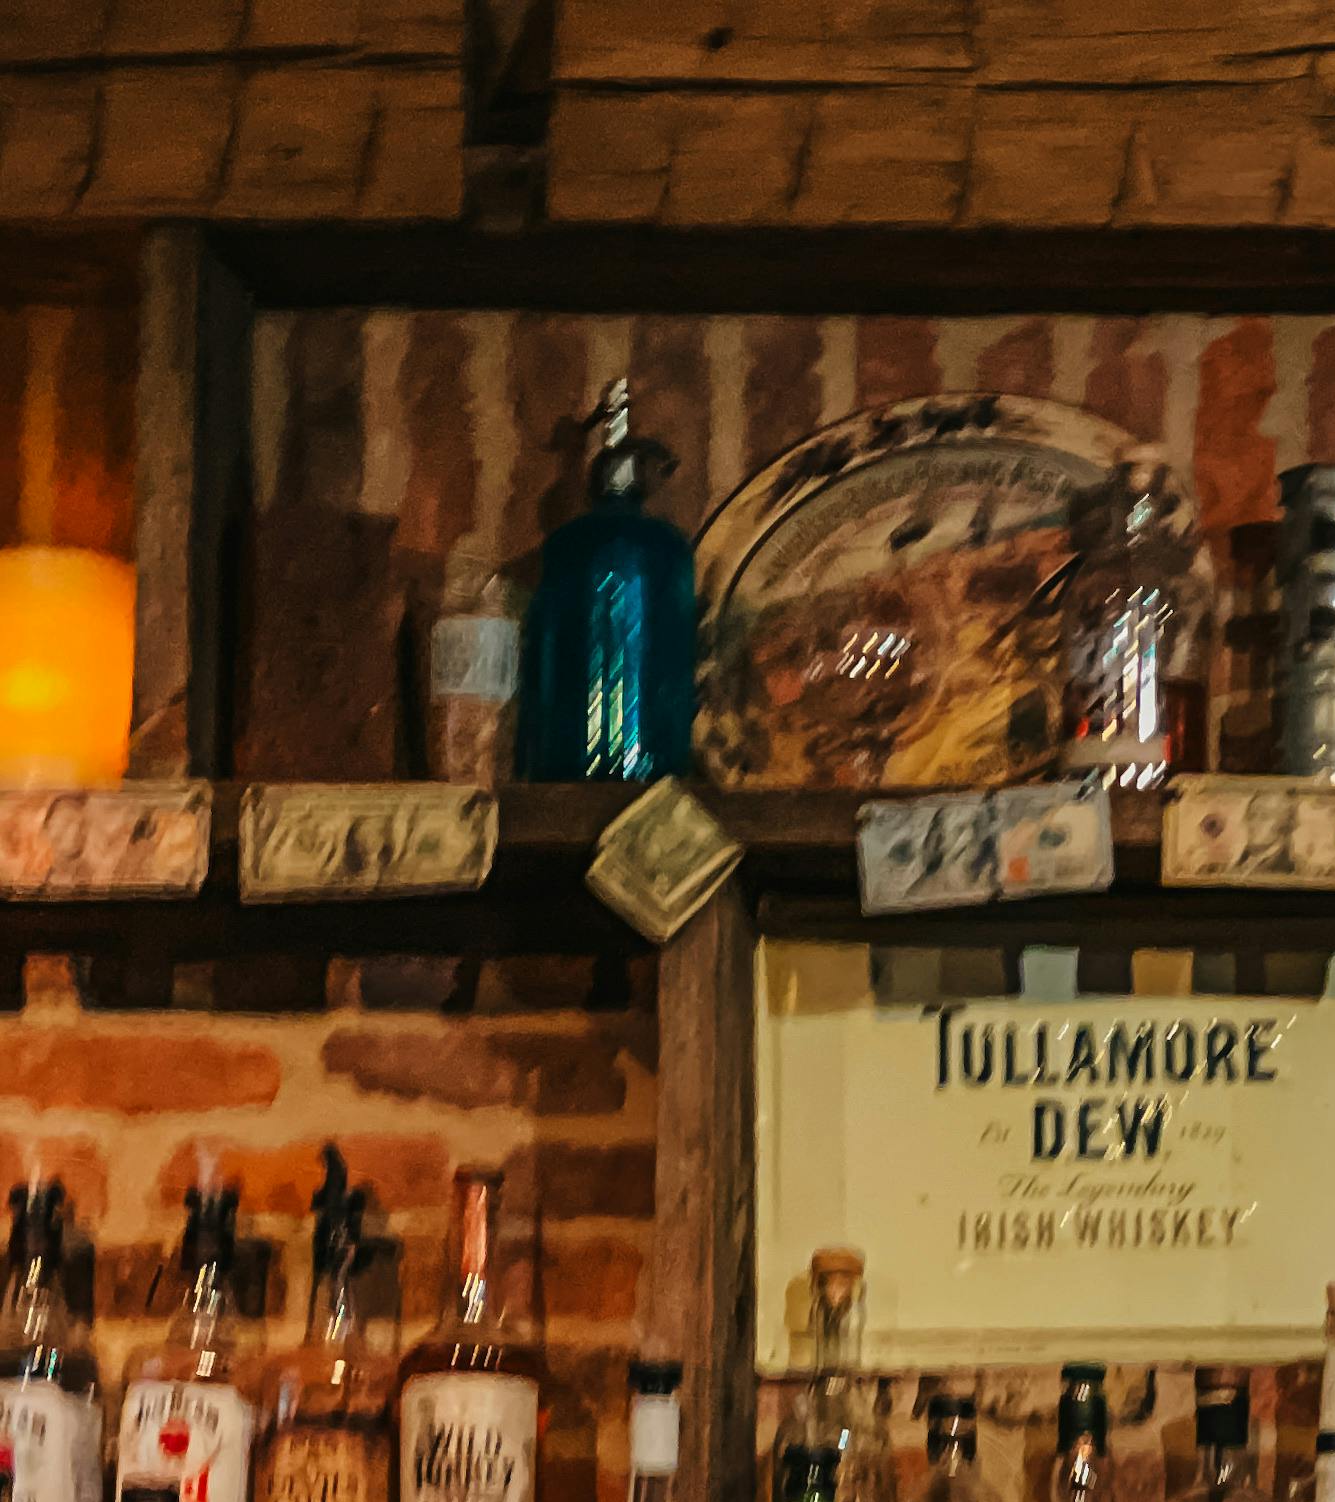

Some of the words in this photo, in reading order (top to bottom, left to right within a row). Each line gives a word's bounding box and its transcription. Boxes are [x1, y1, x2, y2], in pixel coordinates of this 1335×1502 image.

[921, 1003, 1280, 1089] TULLAMORE
[1031, 1096, 1165, 1161] DEW
[957, 1207, 1056, 1250] IRISH
[1073, 1204, 1242, 1249] WHISKEY
